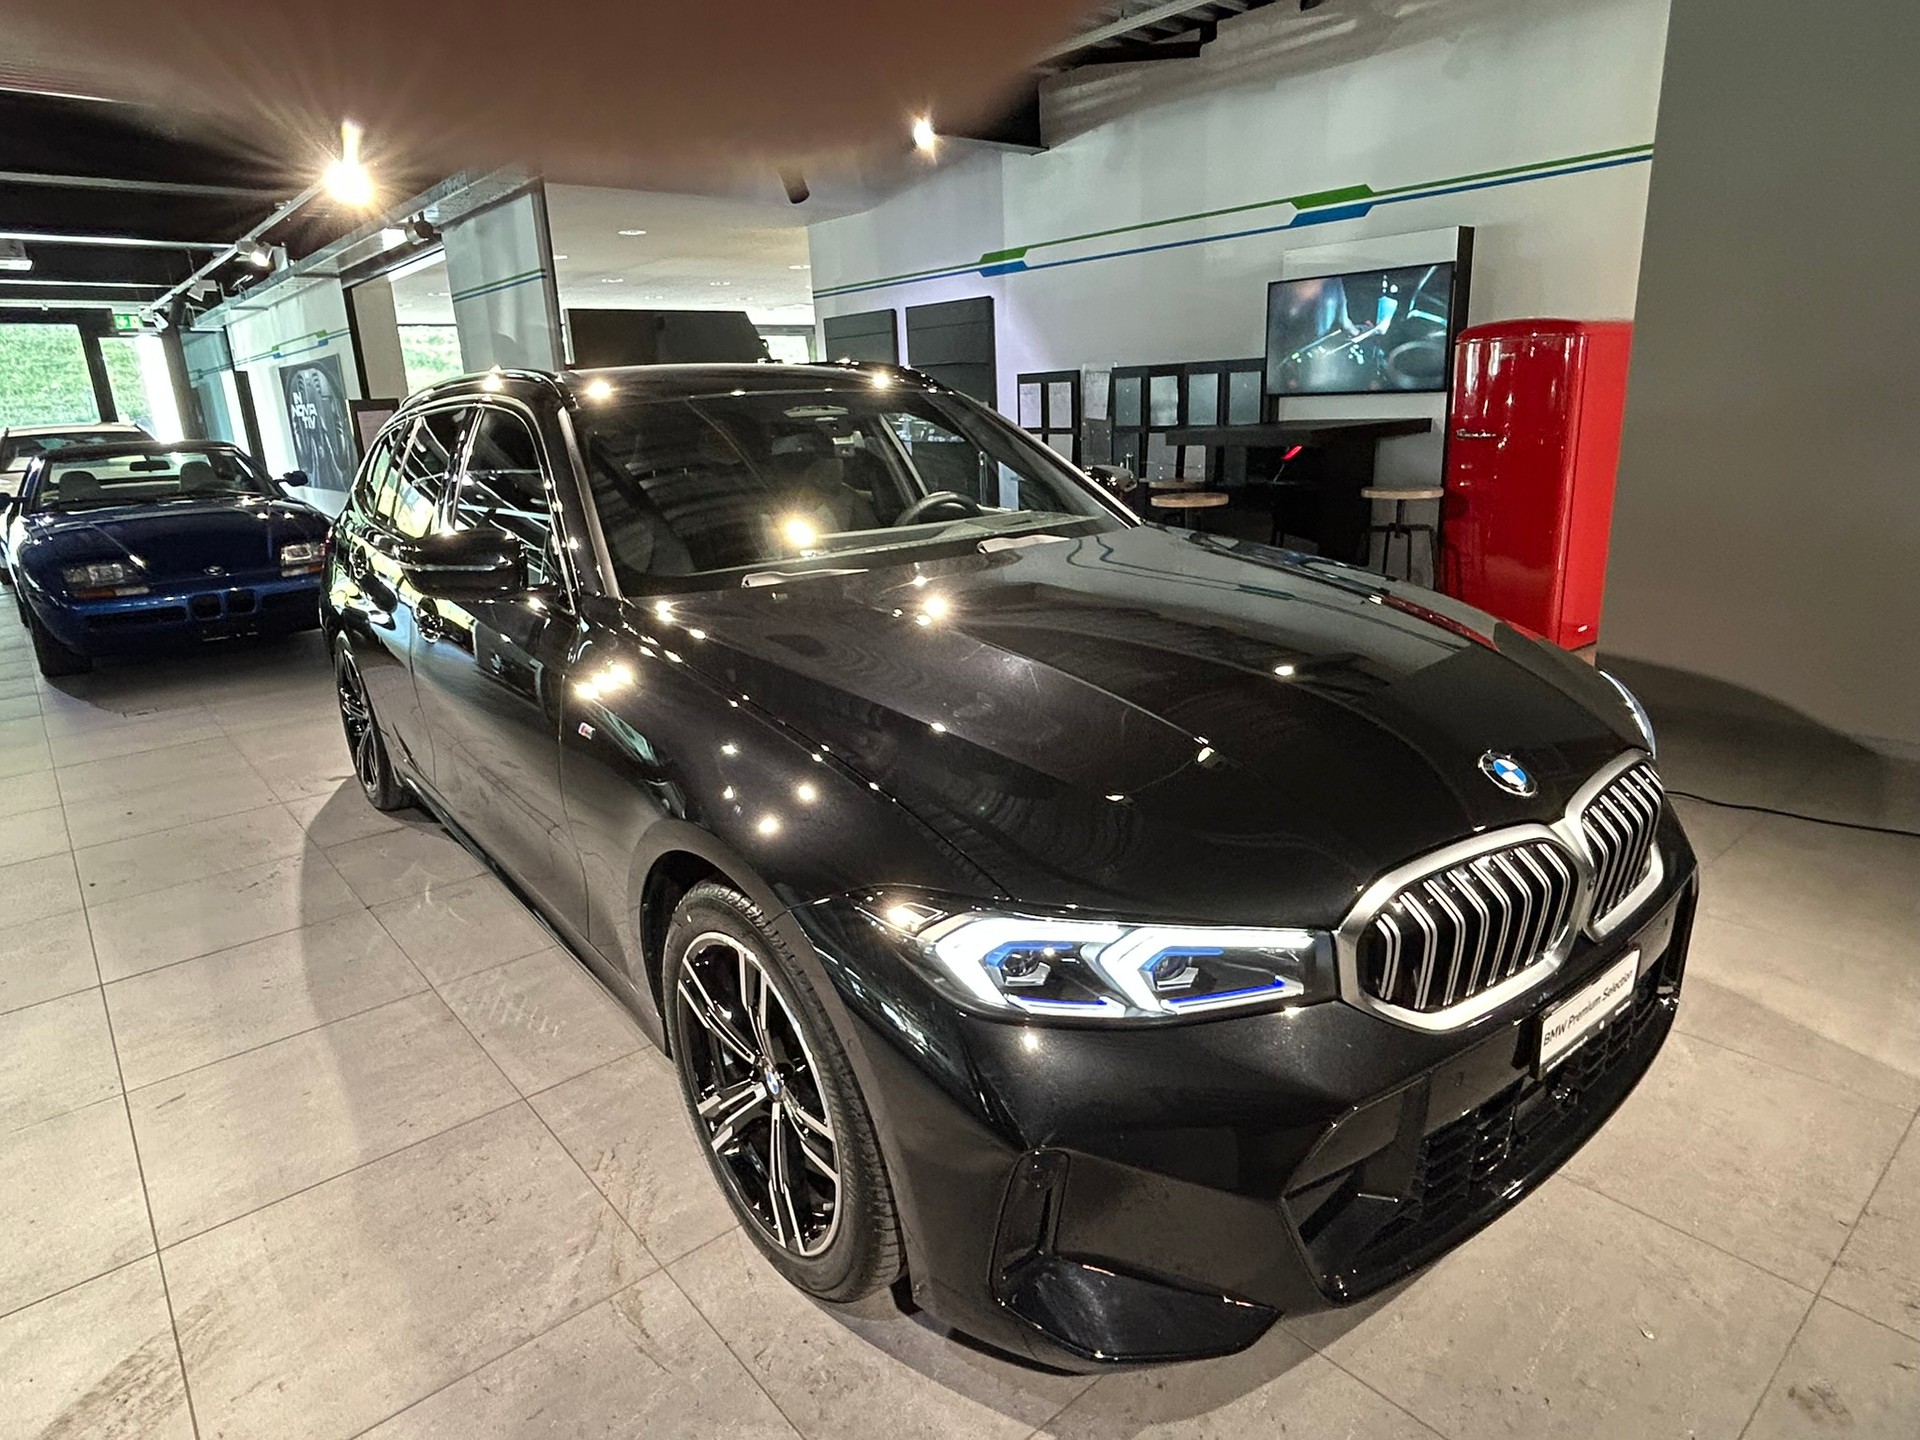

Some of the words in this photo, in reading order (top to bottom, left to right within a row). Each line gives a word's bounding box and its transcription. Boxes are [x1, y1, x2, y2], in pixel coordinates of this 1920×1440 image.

[1543, 1019, 1568, 1047] BMW
[1567, 995, 1602, 1030] Premium
[1602, 970, 1633, 1001] Selection
